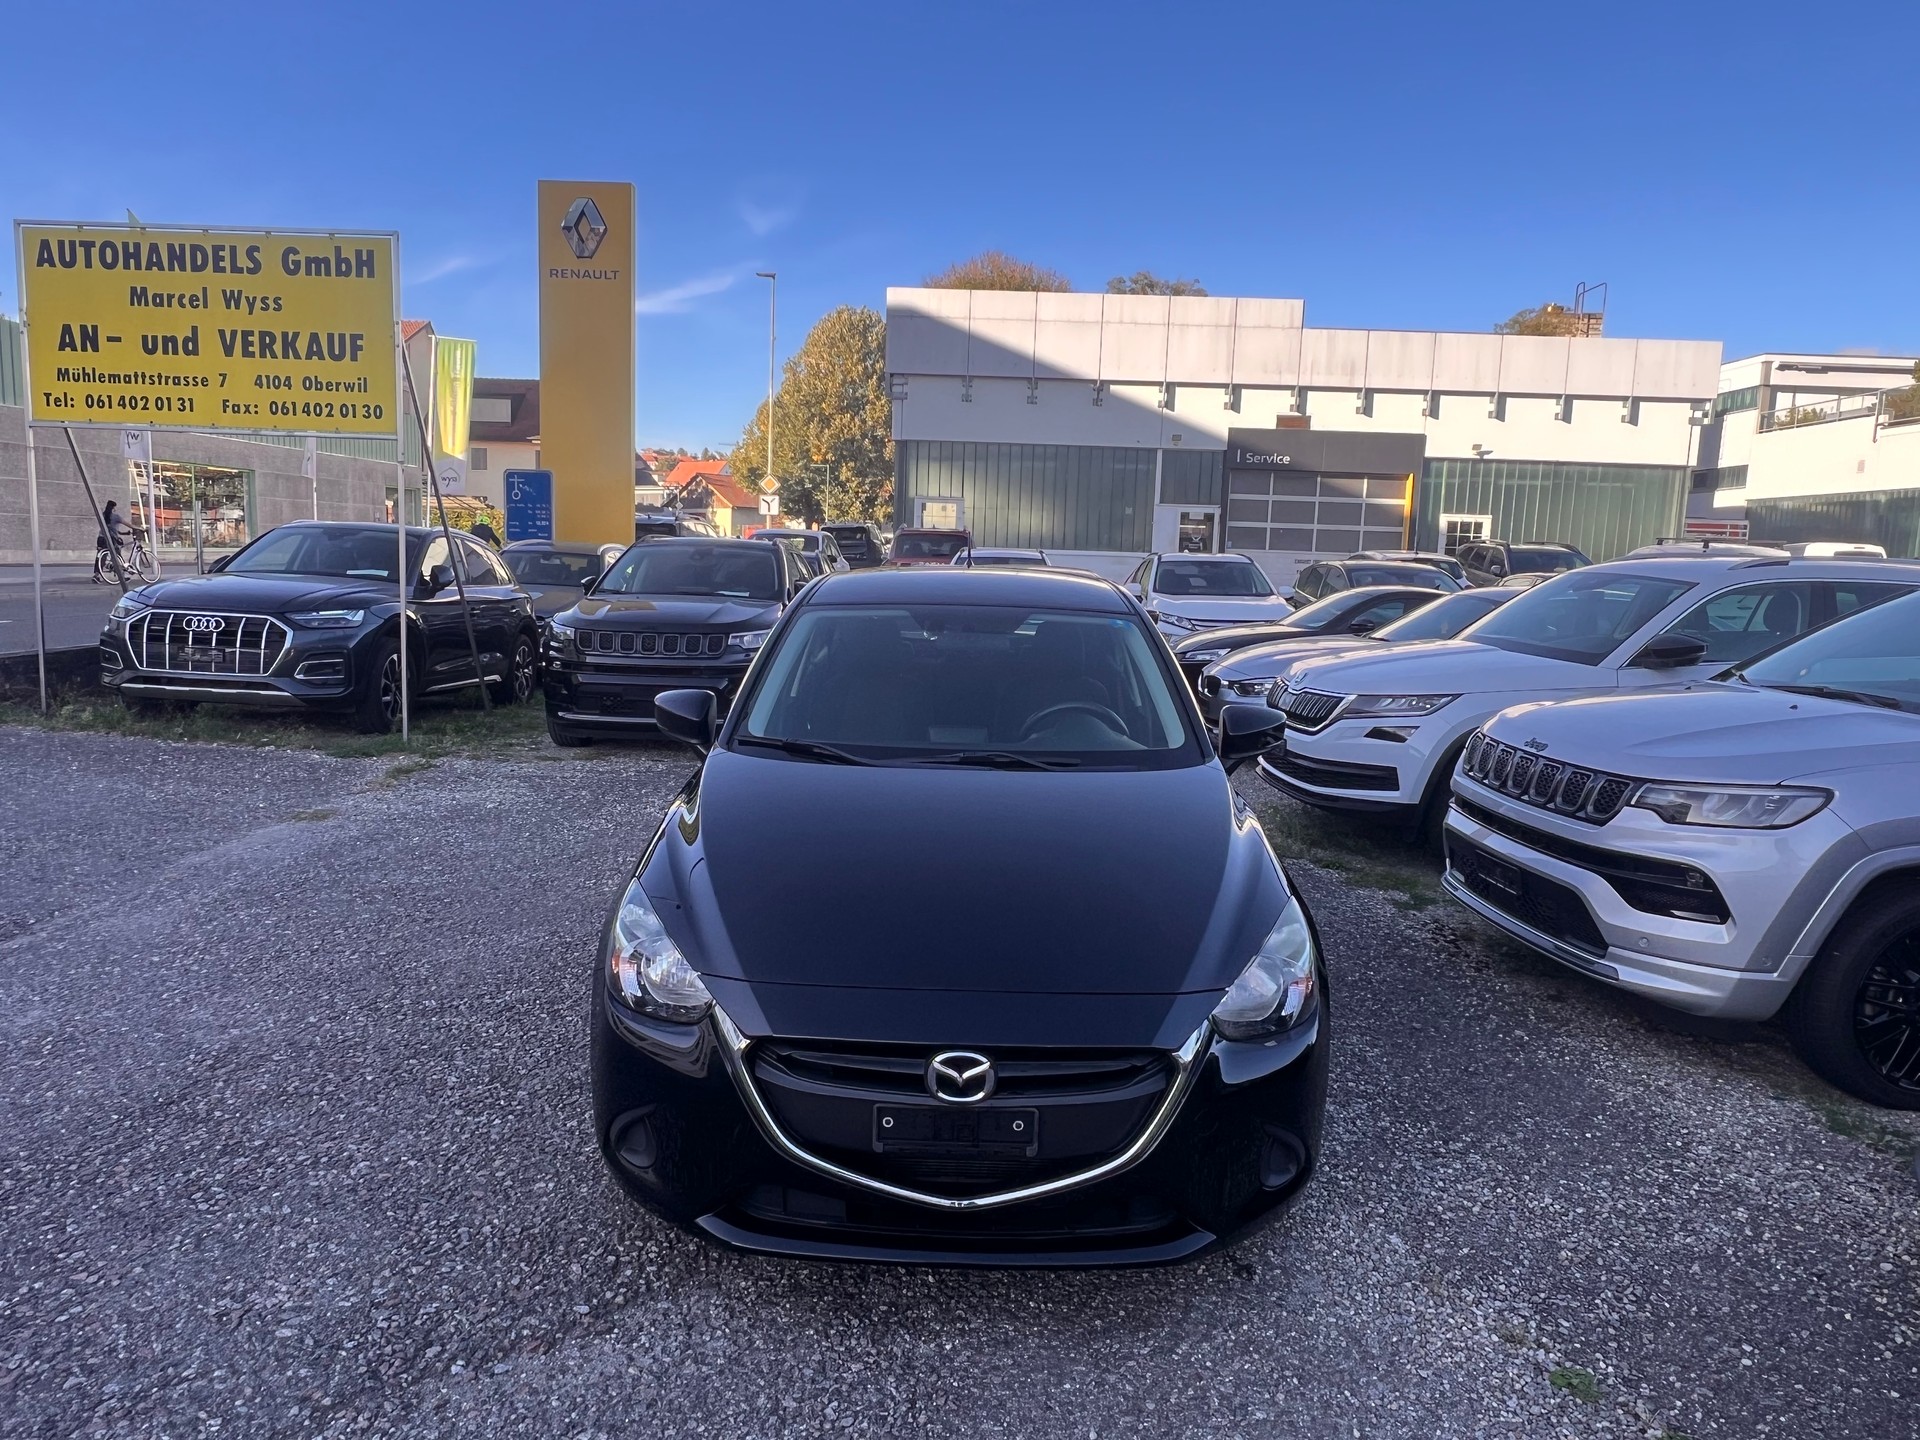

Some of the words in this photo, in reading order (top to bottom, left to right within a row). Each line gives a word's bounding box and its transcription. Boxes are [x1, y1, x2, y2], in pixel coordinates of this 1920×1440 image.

[36, 239, 262, 276] AUTOHANDELS
[281, 246, 375, 279] GmbH
[549, 268, 620, 280] RENAULT
[129, 286, 208, 309] Marcel
[221, 289, 283, 316] Wyss
[141, 325, 199, 356] und
[217, 329, 364, 362] VERKAUF
[56, 366, 209, 388] Mühlemattstrasse
[218, 372, 228, 388] 7
[254, 374, 293, 390] 4104
[302, 375, 368, 393] Oberwil
[43, 392, 75, 409] Tel:
[222, 399, 259, 415] Fax:
[1245, 452, 1291, 465] Service
